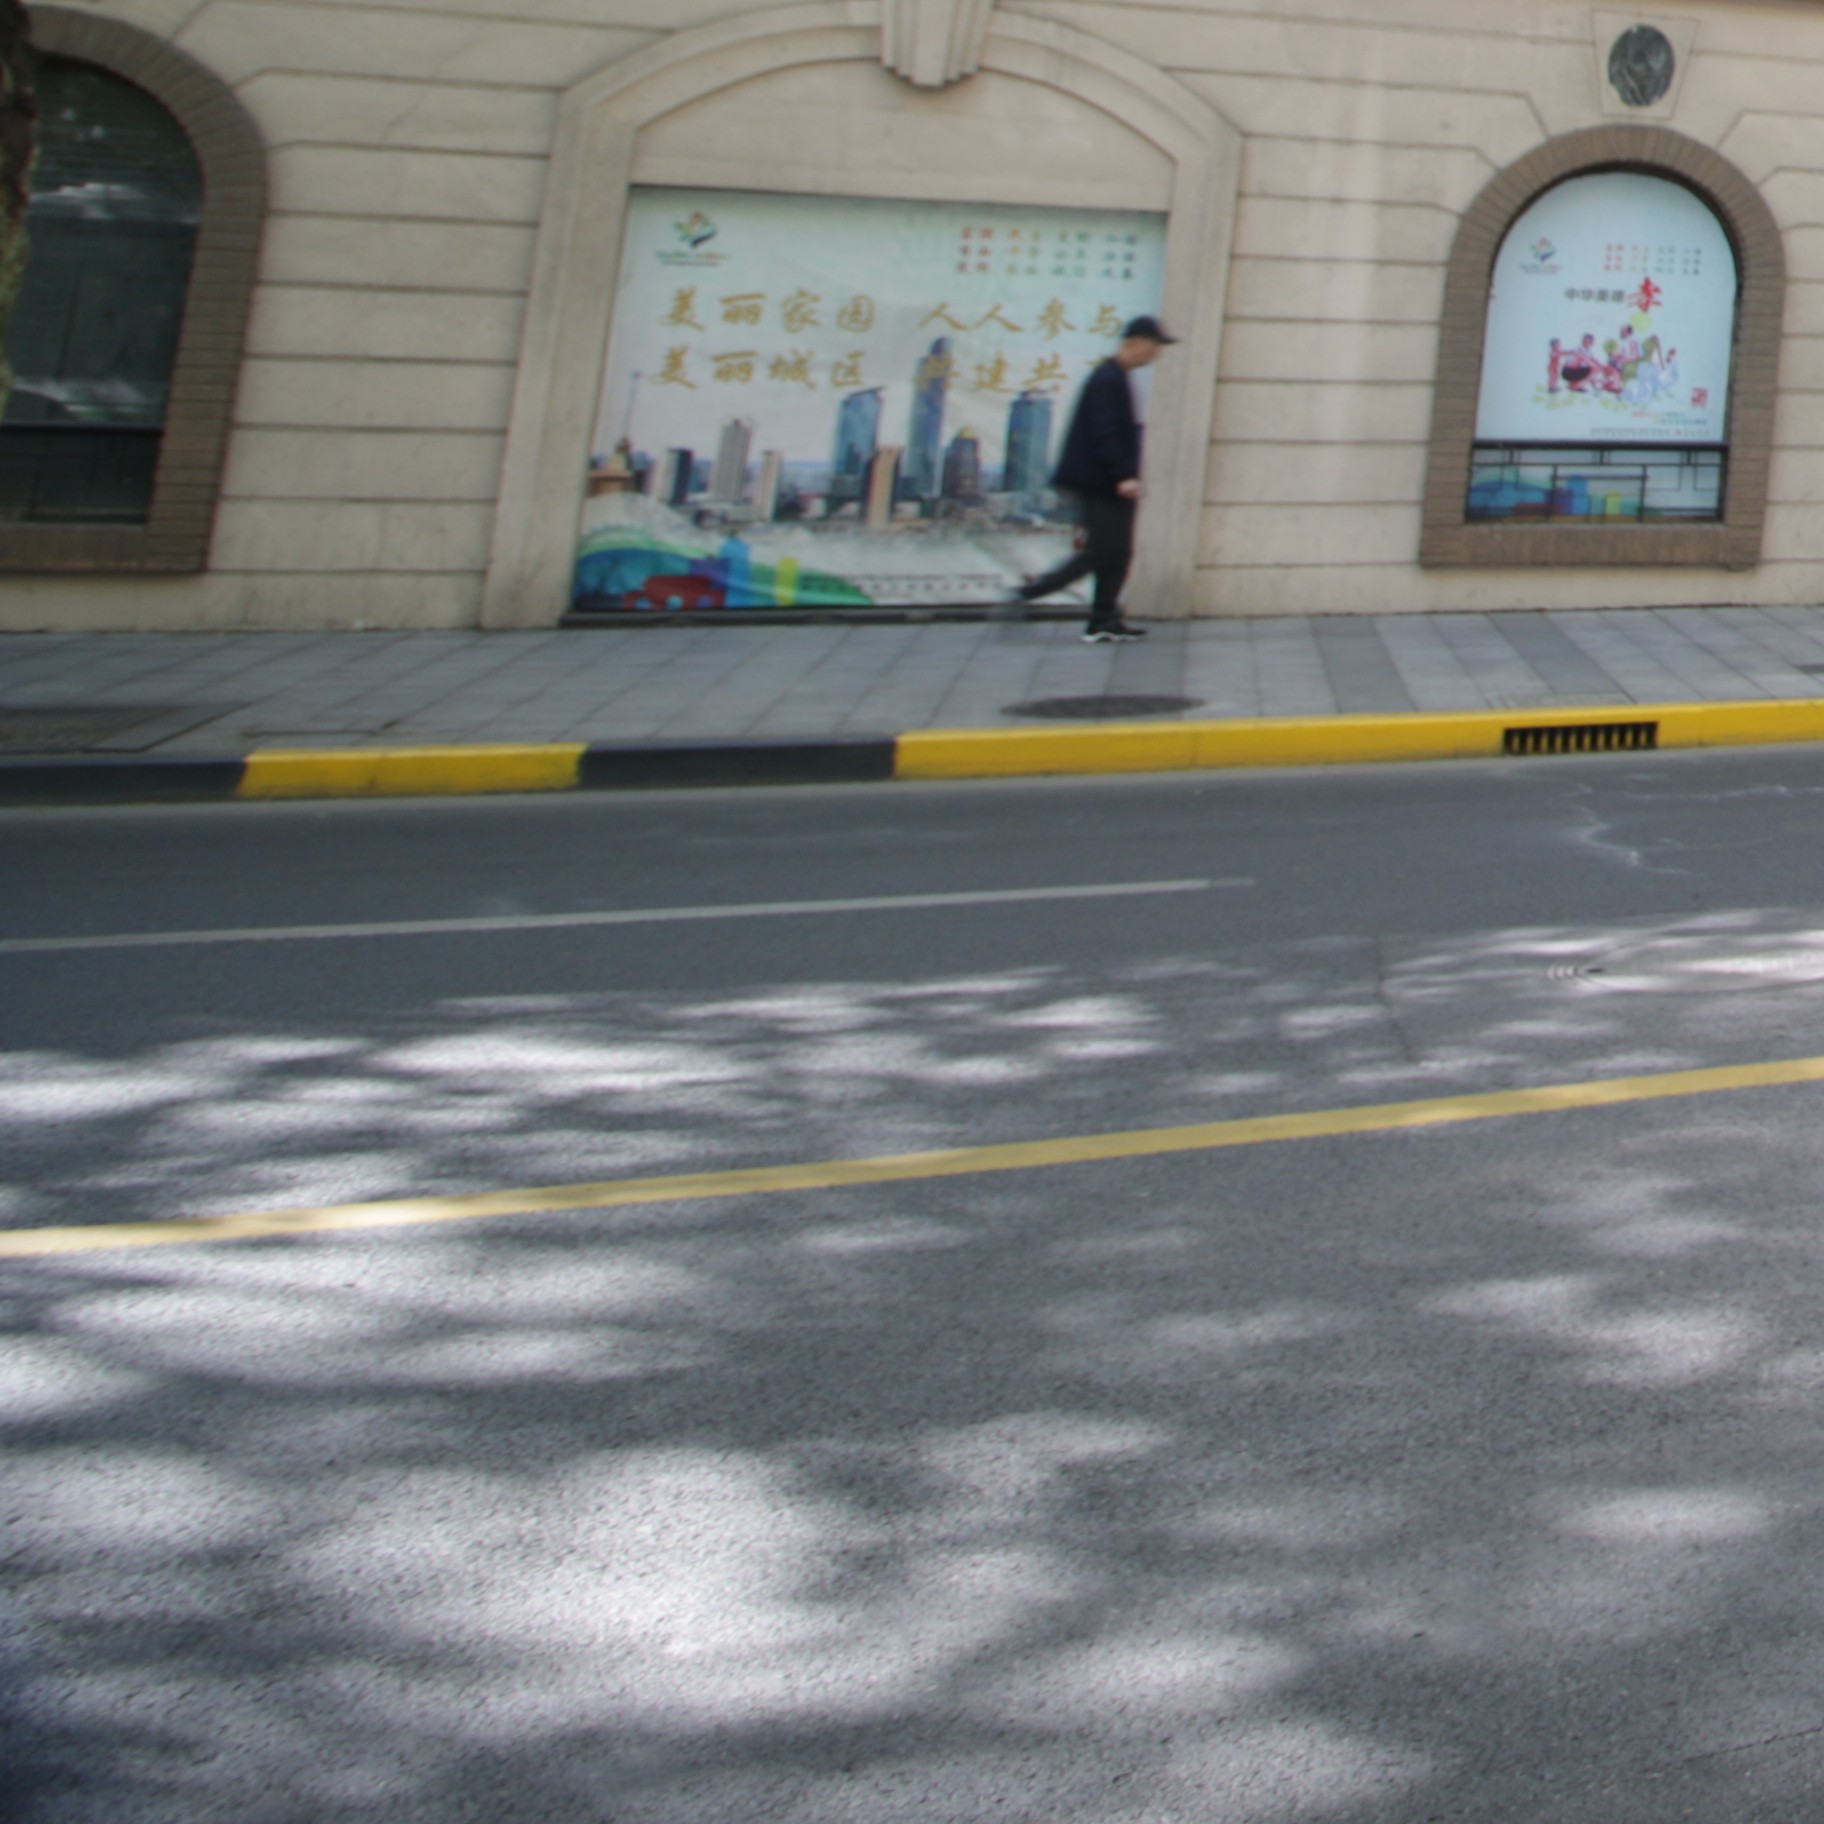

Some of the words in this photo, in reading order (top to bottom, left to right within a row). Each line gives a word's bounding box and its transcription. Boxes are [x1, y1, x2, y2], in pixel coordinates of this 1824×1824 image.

[659, 287, 877, 334] 美丽家园
[919, 297, 1125, 340] 人人参与
[650, 345, 865, 390] 美丽城区
[914, 350, 1111, 393] 共建共
